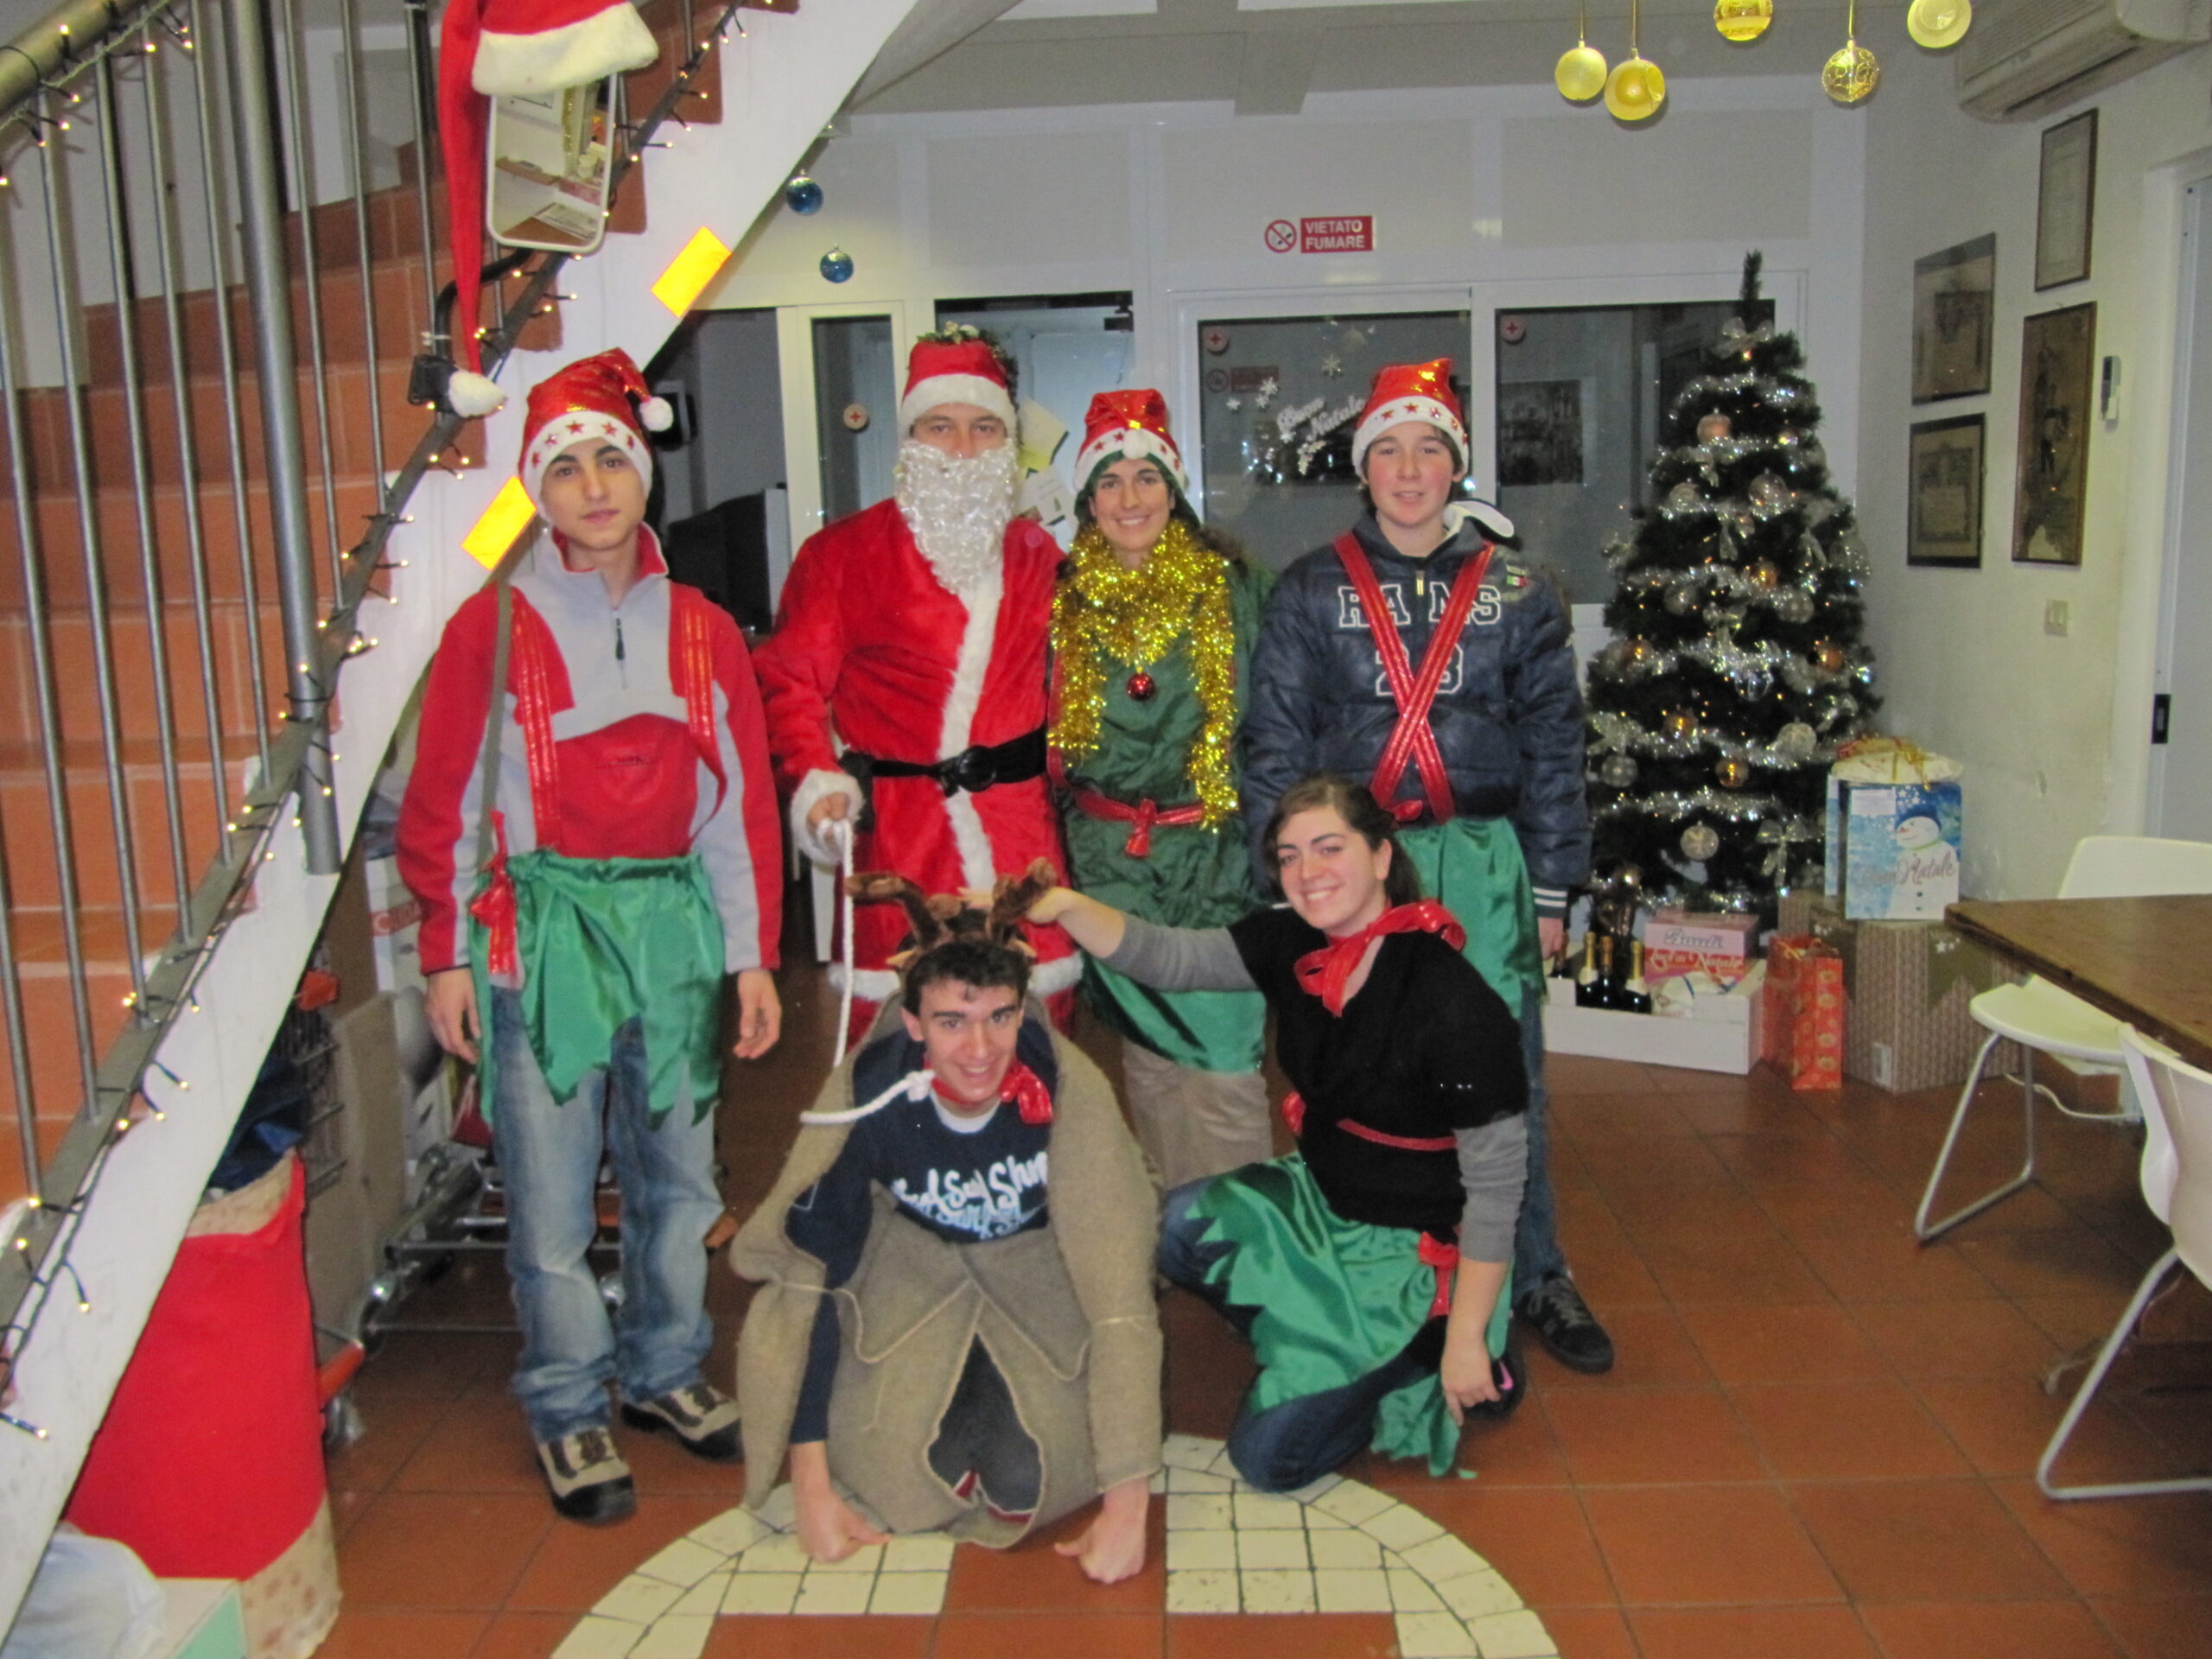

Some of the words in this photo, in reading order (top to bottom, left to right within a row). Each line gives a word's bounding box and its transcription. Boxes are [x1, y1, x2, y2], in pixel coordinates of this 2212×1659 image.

[1305, 219, 1363, 234] VIETATO
[1306, 235, 1365, 250] FUMARE
[1896, 851, 1956, 885] Natale
